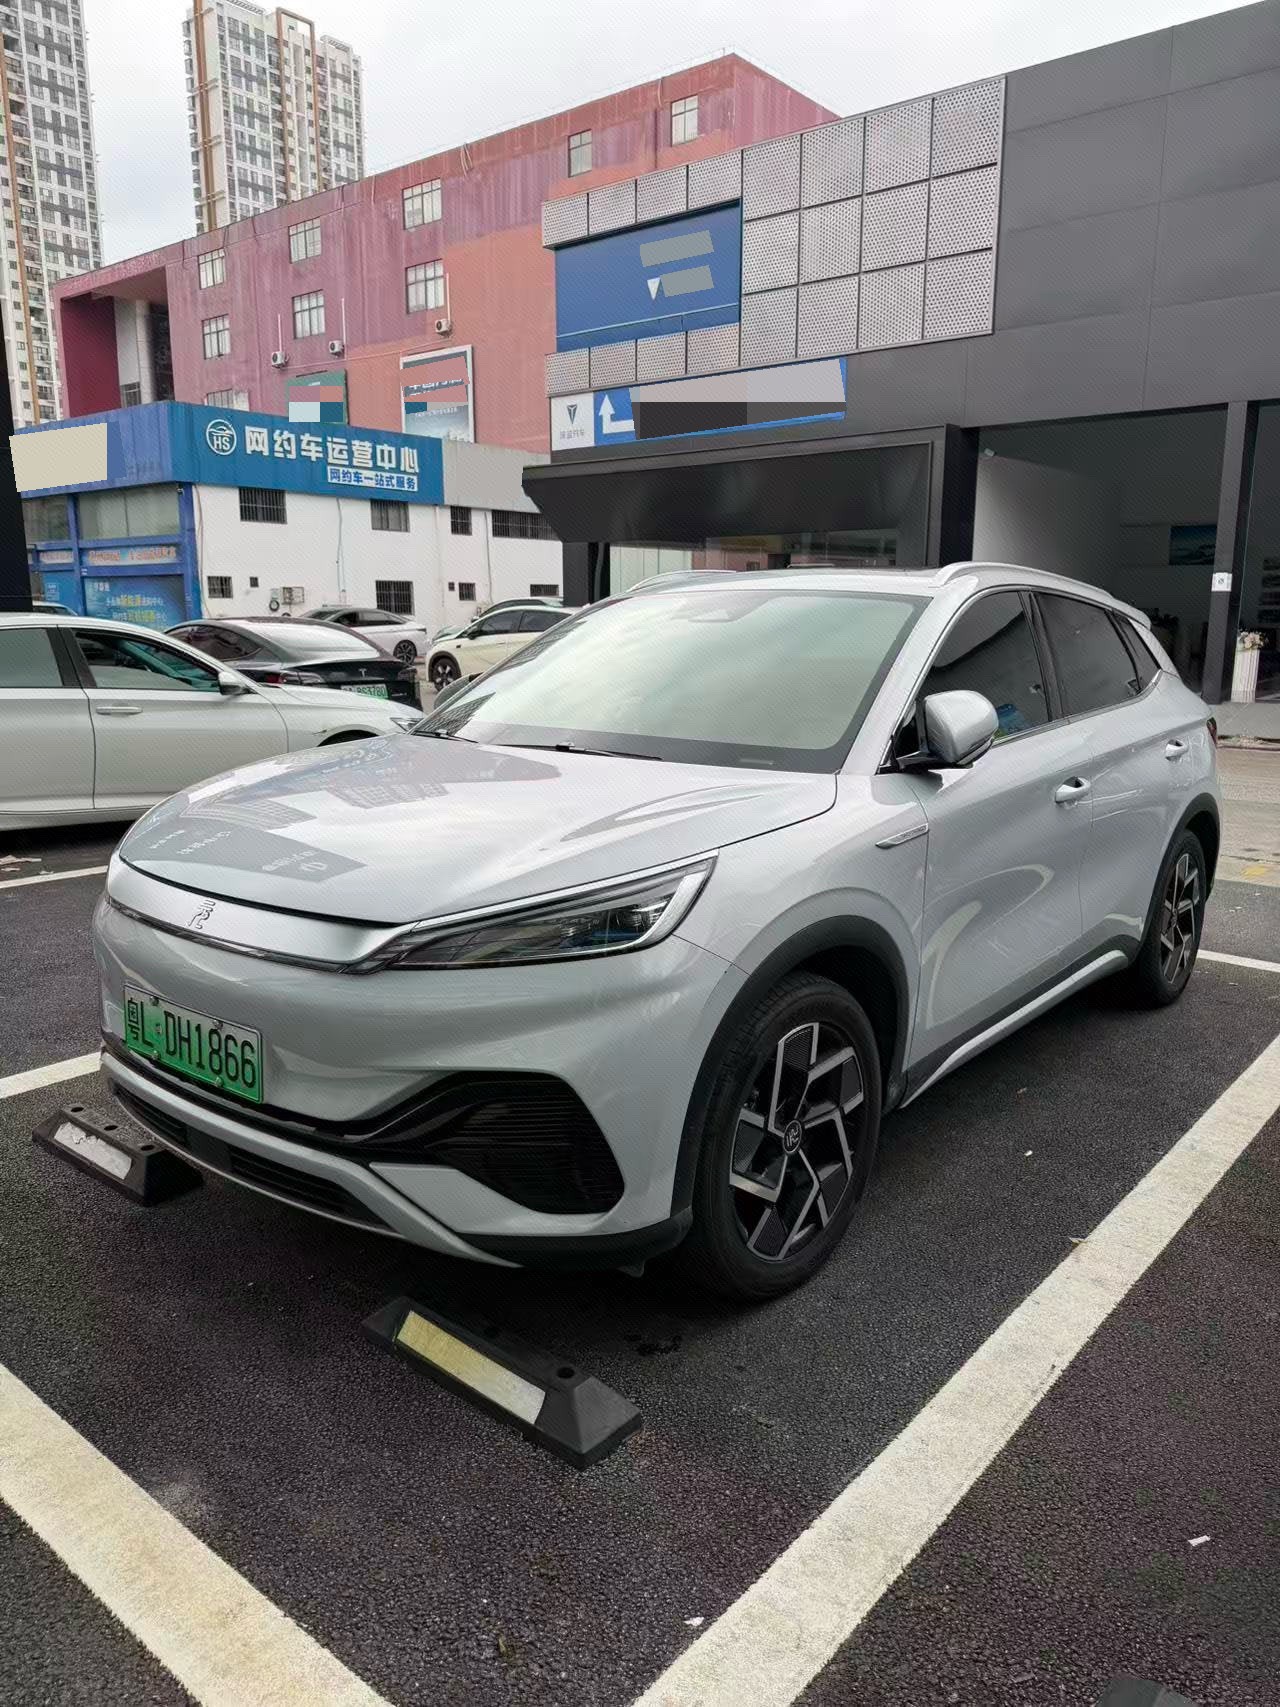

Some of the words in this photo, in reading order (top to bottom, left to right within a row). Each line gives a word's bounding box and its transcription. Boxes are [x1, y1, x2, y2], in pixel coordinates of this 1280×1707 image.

[213, 435, 231, 451] HS
[245, 425, 419, 473] 网约车运营中心
[330, 468, 416, 490] 网约车一站式服务
